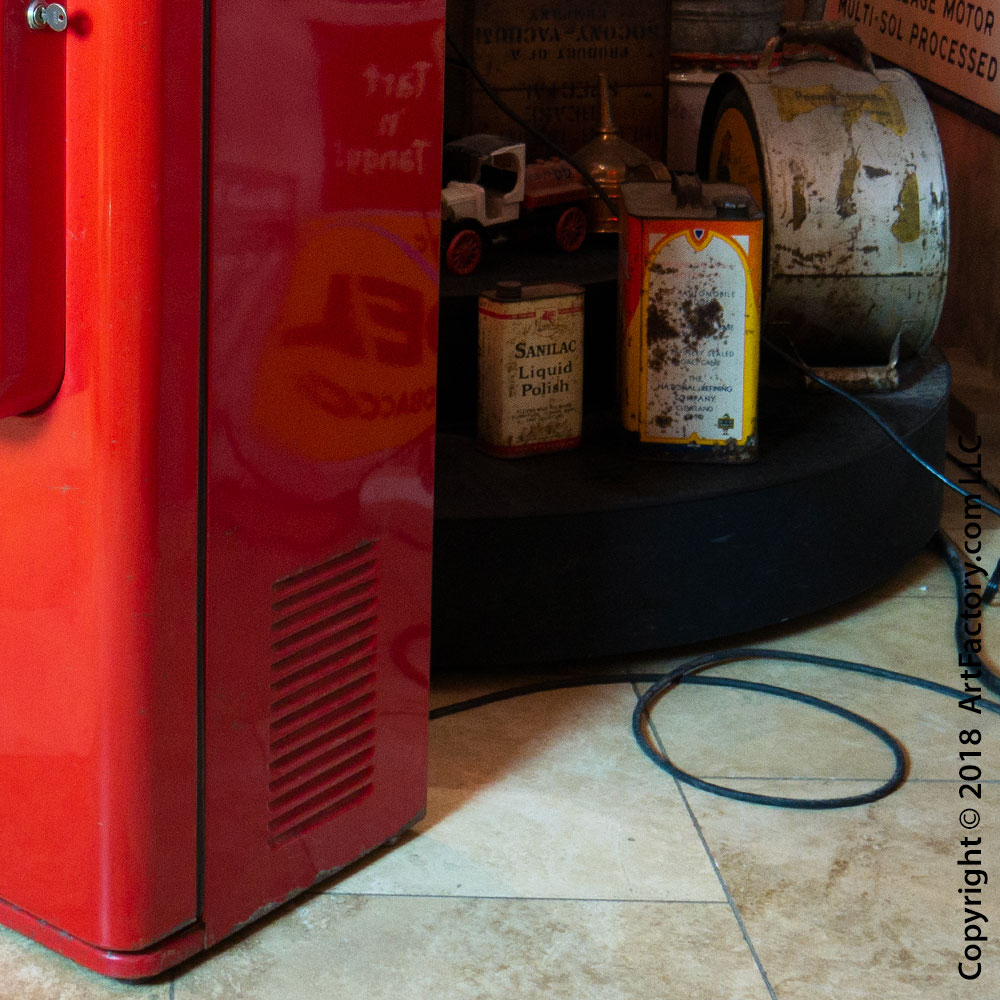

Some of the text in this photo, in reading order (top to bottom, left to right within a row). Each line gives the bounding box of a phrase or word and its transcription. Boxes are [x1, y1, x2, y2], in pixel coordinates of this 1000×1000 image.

[909, 23, 998, 82] PROCESSED
[514, 339, 577, 359] SANILAC
[518, 360, 573, 380] Liquid
[521, 379, 570, 397] Polish
